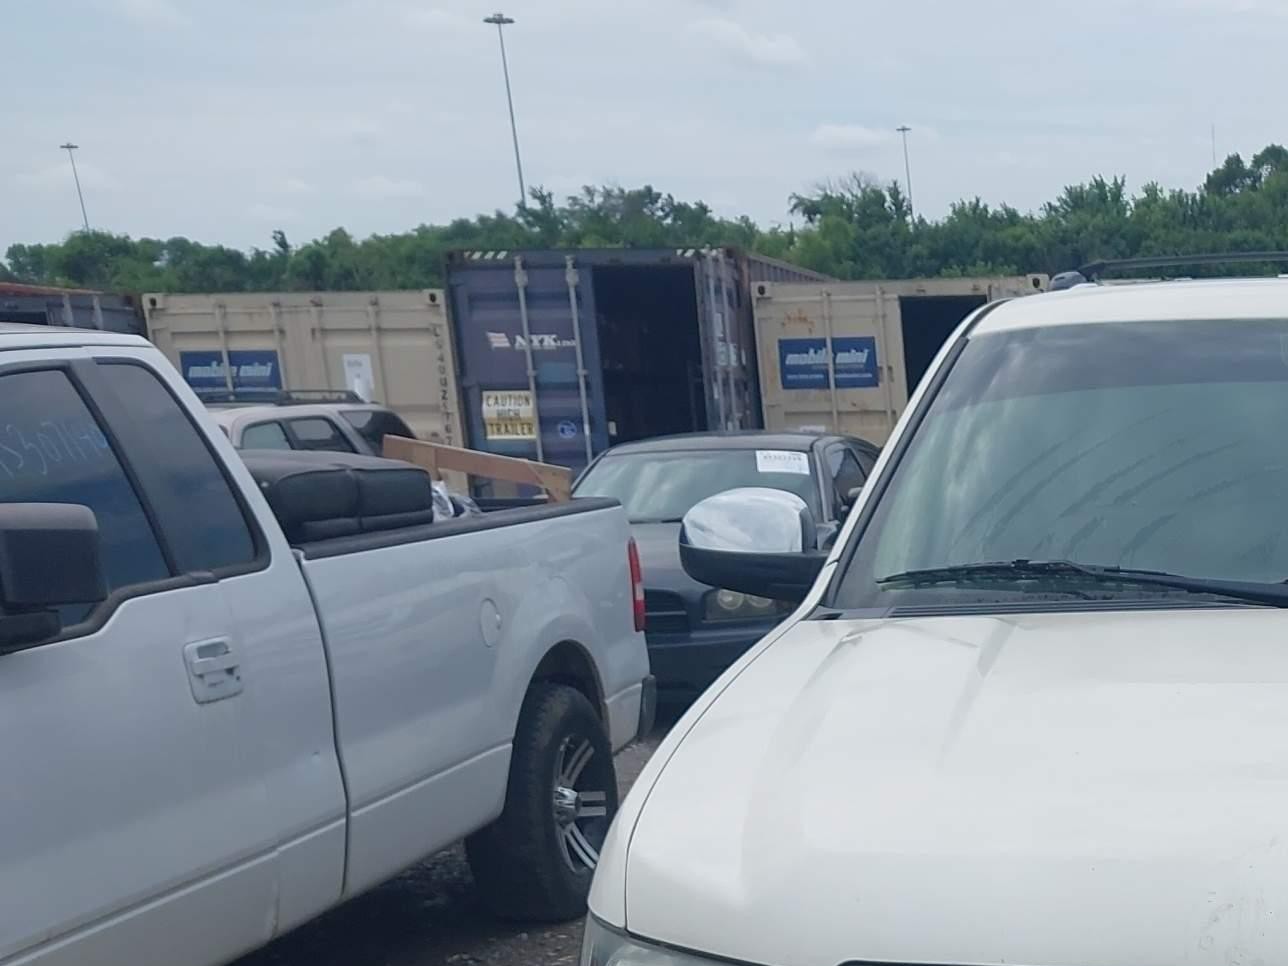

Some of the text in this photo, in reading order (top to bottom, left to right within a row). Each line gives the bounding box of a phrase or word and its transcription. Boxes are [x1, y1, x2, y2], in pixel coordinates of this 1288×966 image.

[835, 349, 869, 363] mini
[188, 360, 238, 378] mobie
[486, 393, 531, 408] CAUTION
[488, 422, 535, 437] TRAILER
